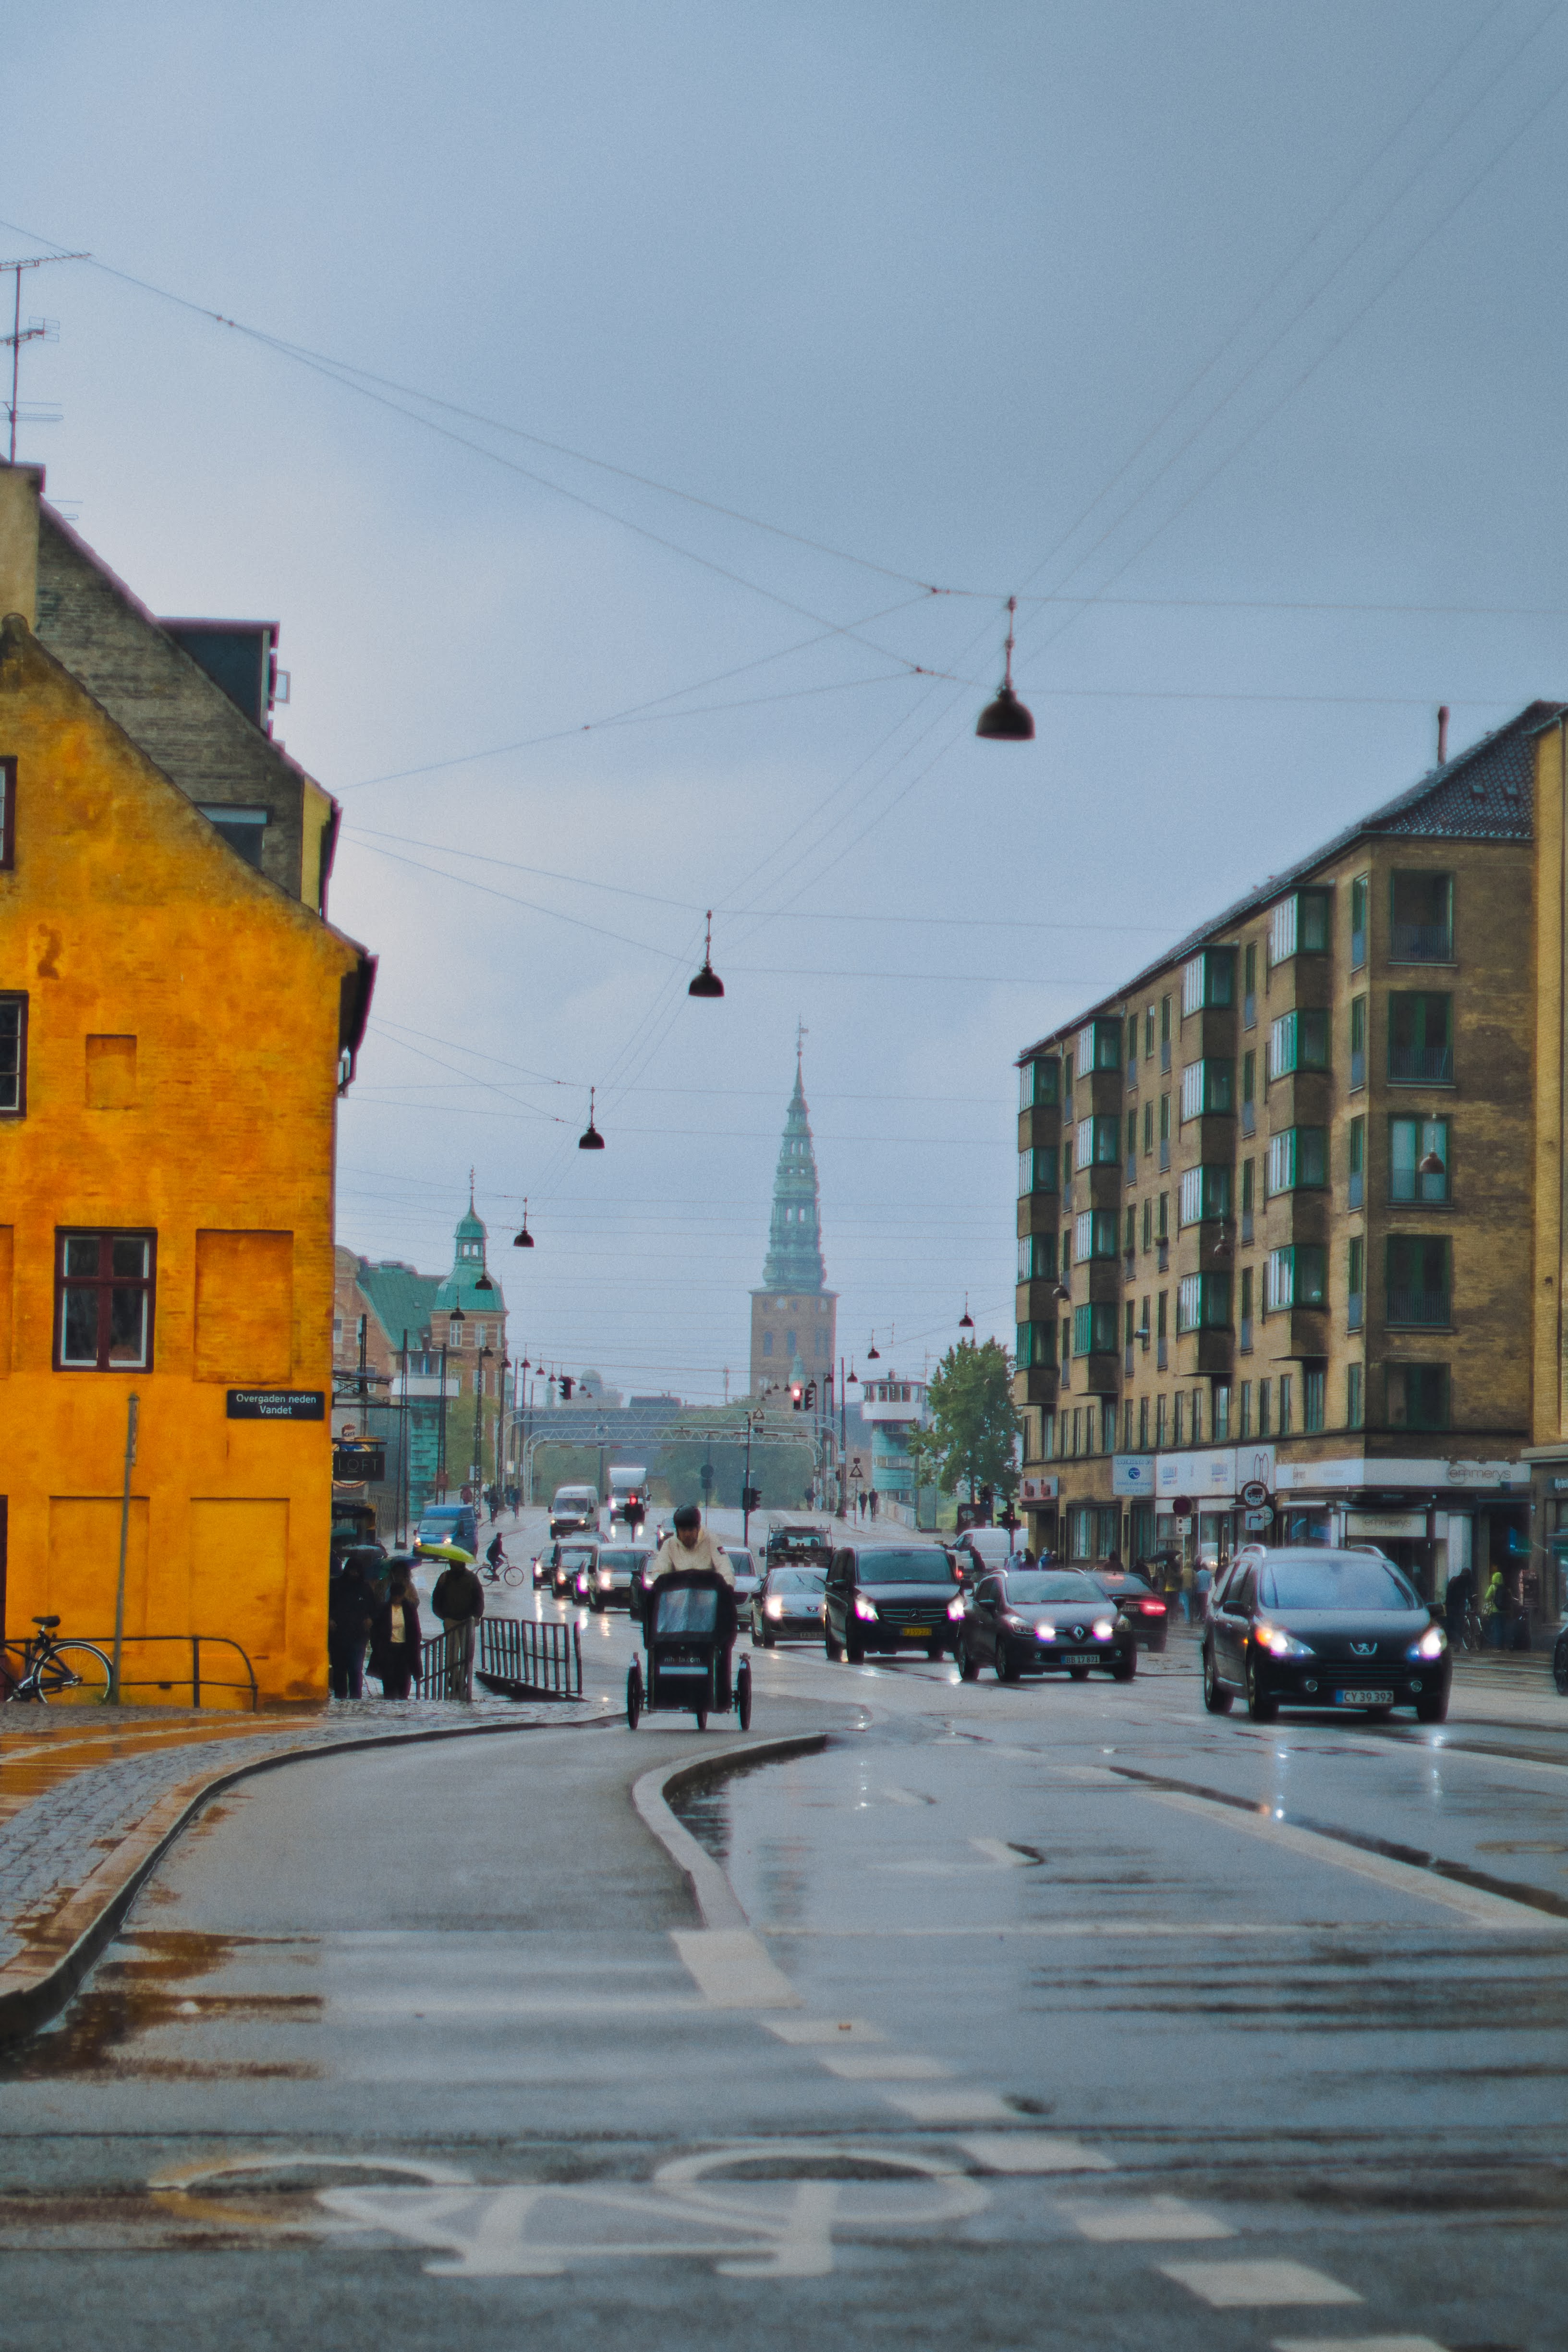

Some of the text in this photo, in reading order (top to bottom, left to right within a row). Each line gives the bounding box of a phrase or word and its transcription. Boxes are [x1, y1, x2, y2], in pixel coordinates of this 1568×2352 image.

[236, 1394, 316, 1404] Overgaden neden
[260, 1405, 292, 1414] Vandet
[339, 1458, 378, 1472] LOFT
[1450, 1469, 1511, 1480] emmerys
[1364, 1519, 1411, 1529] emmerys
[1344, 1692, 1392, 1702] CY 39 392
